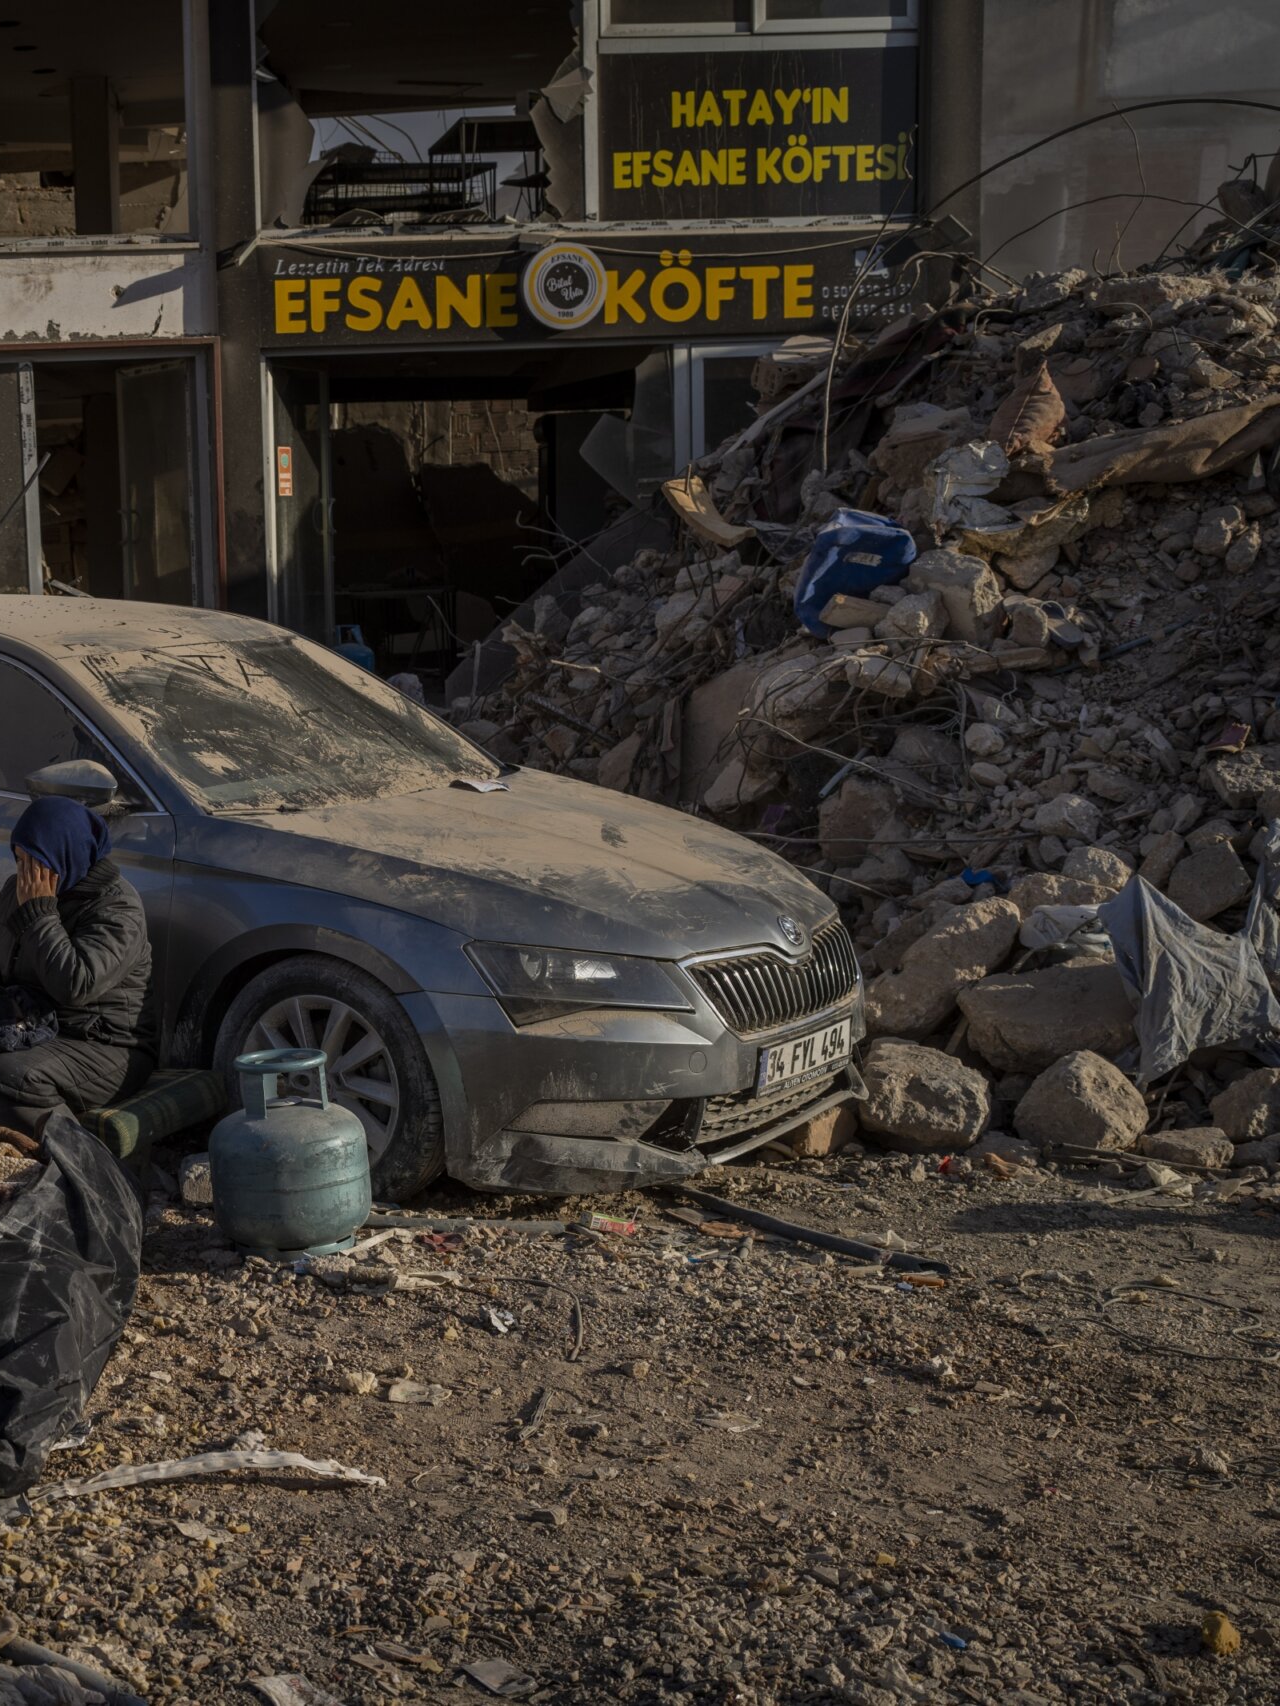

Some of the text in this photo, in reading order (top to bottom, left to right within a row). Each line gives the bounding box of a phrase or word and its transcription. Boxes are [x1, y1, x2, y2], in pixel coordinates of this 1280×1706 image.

[613, 131, 908, 189] EFSANE KÖFTESİ
[274, 256, 446, 275] Lezzetin Tek Adresi
[551, 254, 583, 264] EFSANE
[274, 249, 814, 334] EFSANE KÖFTE
[768, 1025, 844, 1081] 34 FYL 494
